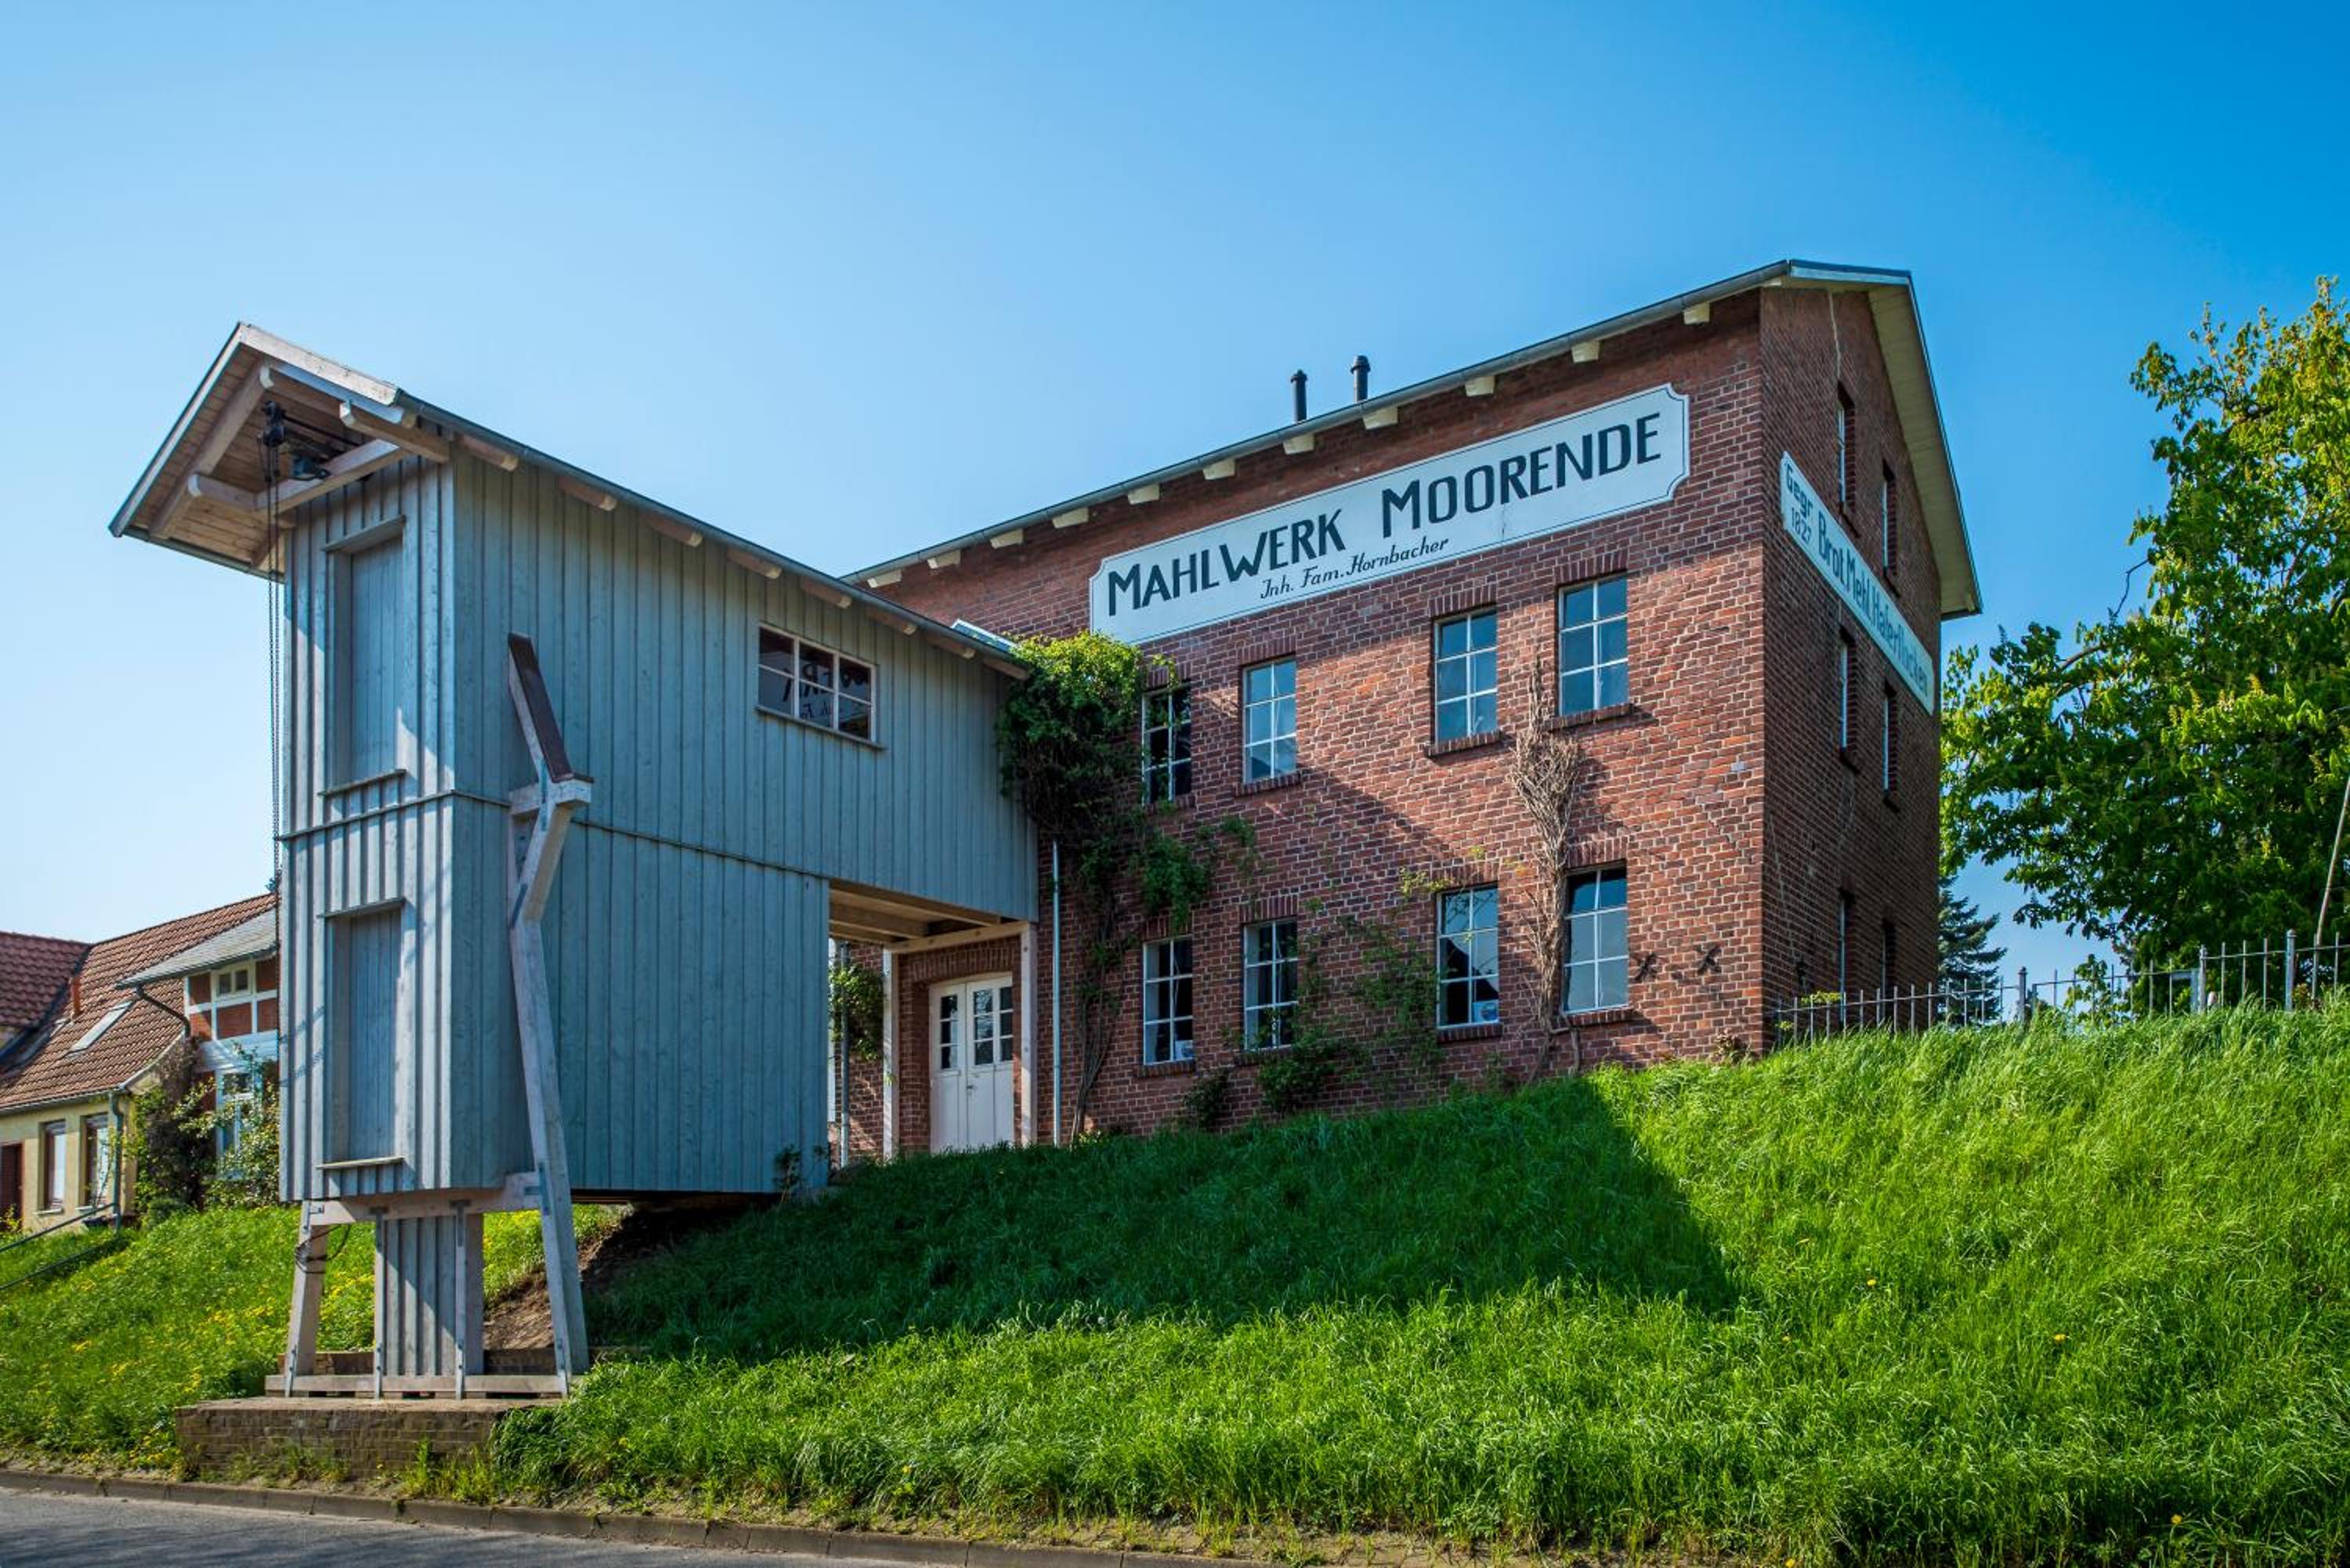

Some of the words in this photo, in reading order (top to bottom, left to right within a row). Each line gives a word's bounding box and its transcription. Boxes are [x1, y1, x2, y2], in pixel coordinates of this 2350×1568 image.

[1108, 508, 1347, 616] MAHLWERK
[1381, 411, 1661, 539] MOORENDE
[1300, 565, 1344, 588] Fam.
[1345, 535, 1450, 576] Hornbacher
